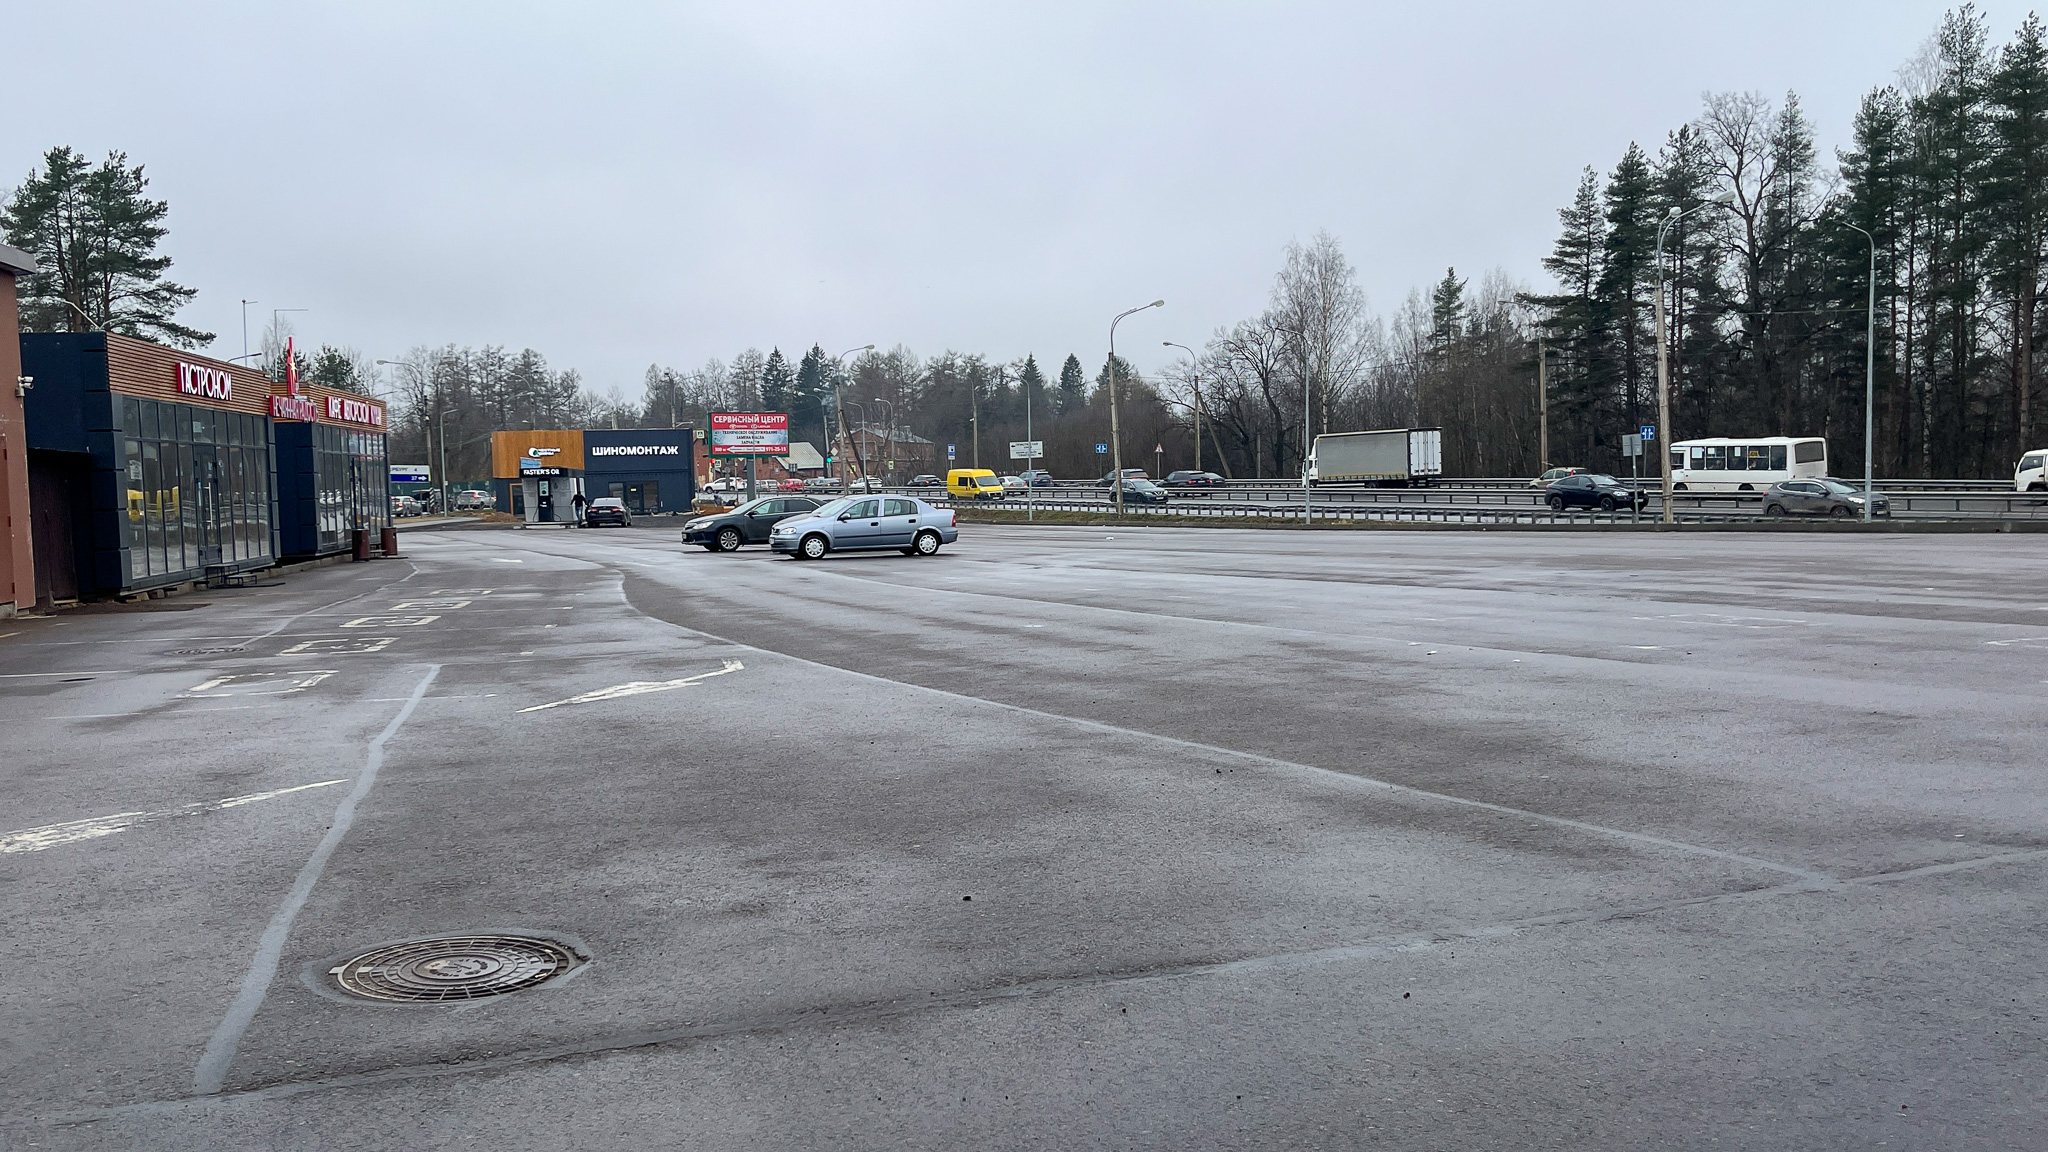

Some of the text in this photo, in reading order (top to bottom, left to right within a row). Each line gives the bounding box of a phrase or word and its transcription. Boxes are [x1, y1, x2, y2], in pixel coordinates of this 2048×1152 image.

[180, 361, 232, 401] ГАСТРОНОМ
[328, 396, 343, 420] КАФЕ
[713, 413, 786, 425] СЕРВИСНЫЙ ЦЕНТР
[592, 446, 679, 456] ШИНОМОНТАЖ
